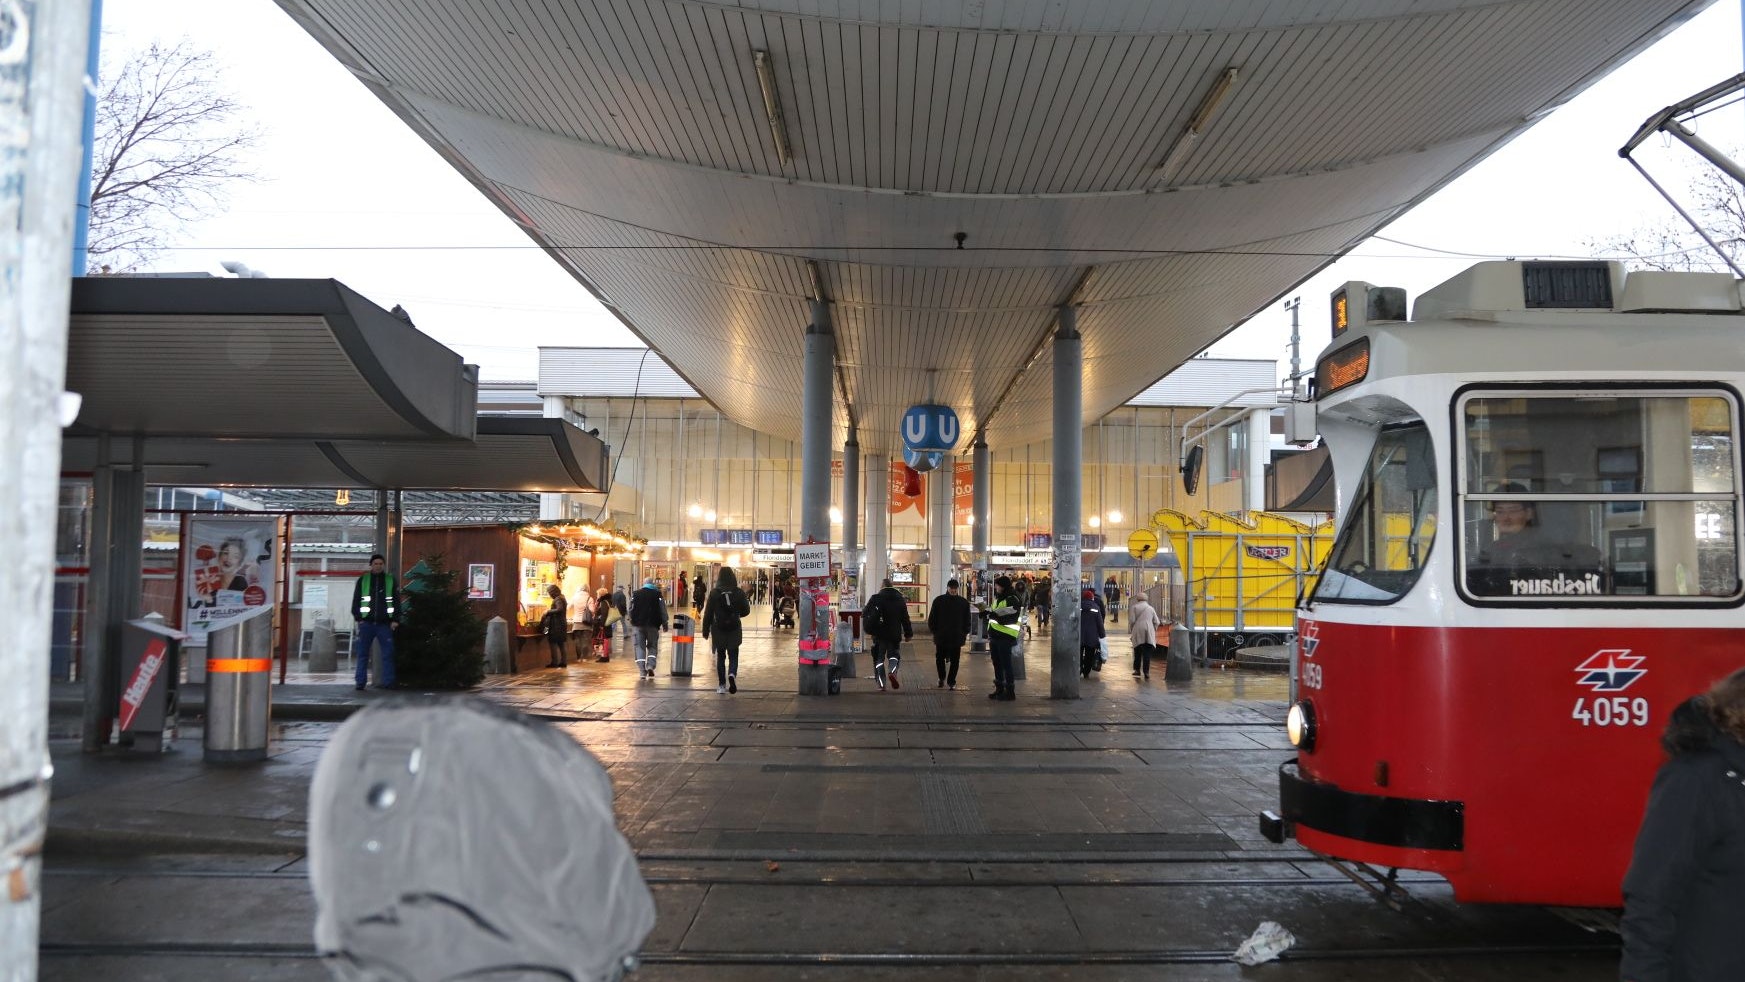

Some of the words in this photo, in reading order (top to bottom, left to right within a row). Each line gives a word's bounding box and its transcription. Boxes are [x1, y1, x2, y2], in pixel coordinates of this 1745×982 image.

[906, 414, 926, 443] U
[939, 414, 955, 443] U
[800, 552, 826, 560] MARKT-
[800, 561, 825, 569] GEBIET
[123, 654, 161, 708] Heute
[1572, 697, 1648, 726] 4059
